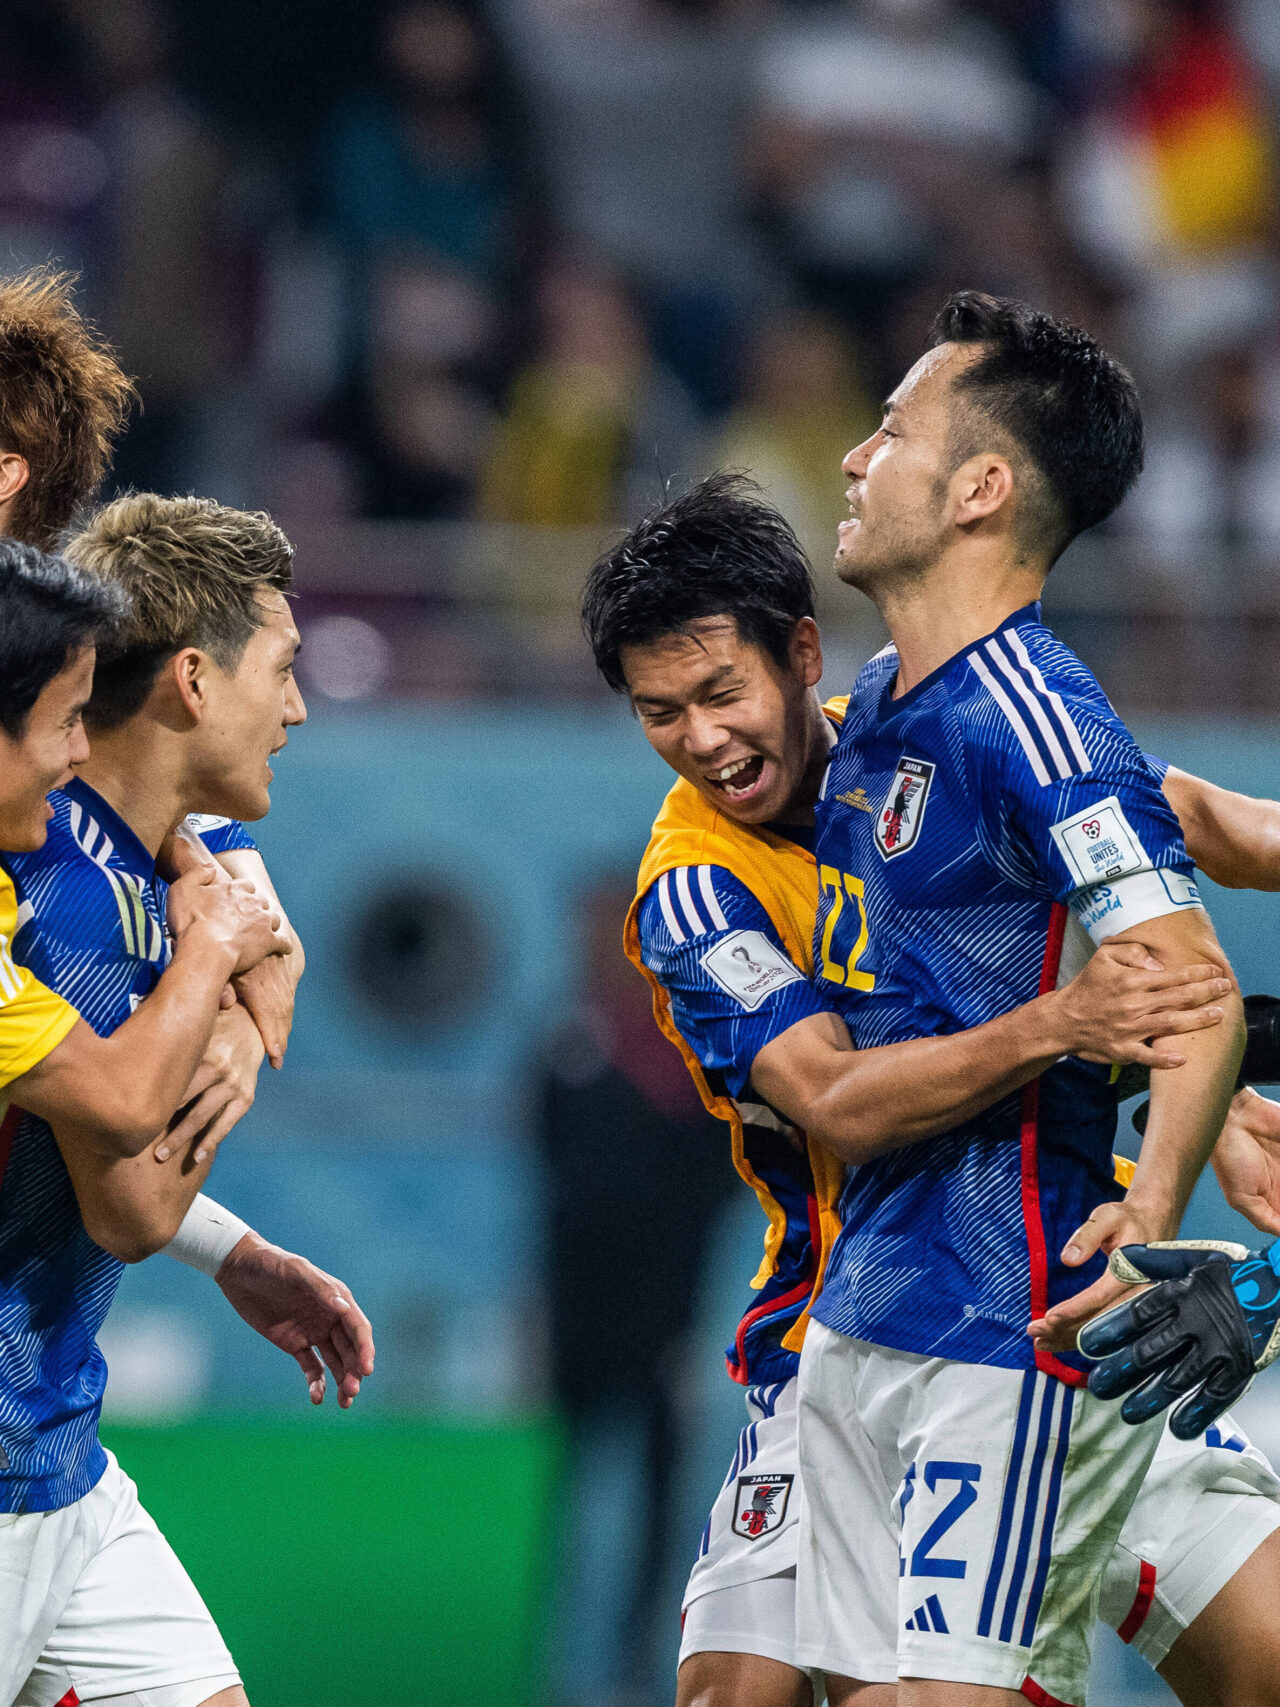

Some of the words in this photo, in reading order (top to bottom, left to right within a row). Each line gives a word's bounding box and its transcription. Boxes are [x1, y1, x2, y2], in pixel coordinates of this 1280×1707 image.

[903, 762, 923, 774] JAPAN
[1087, 837, 1113, 854] FOOTBALL
[1090, 843, 1119, 864] UNITES
[1088, 895, 1122, 922] World
[820, 864, 875, 993] 22
